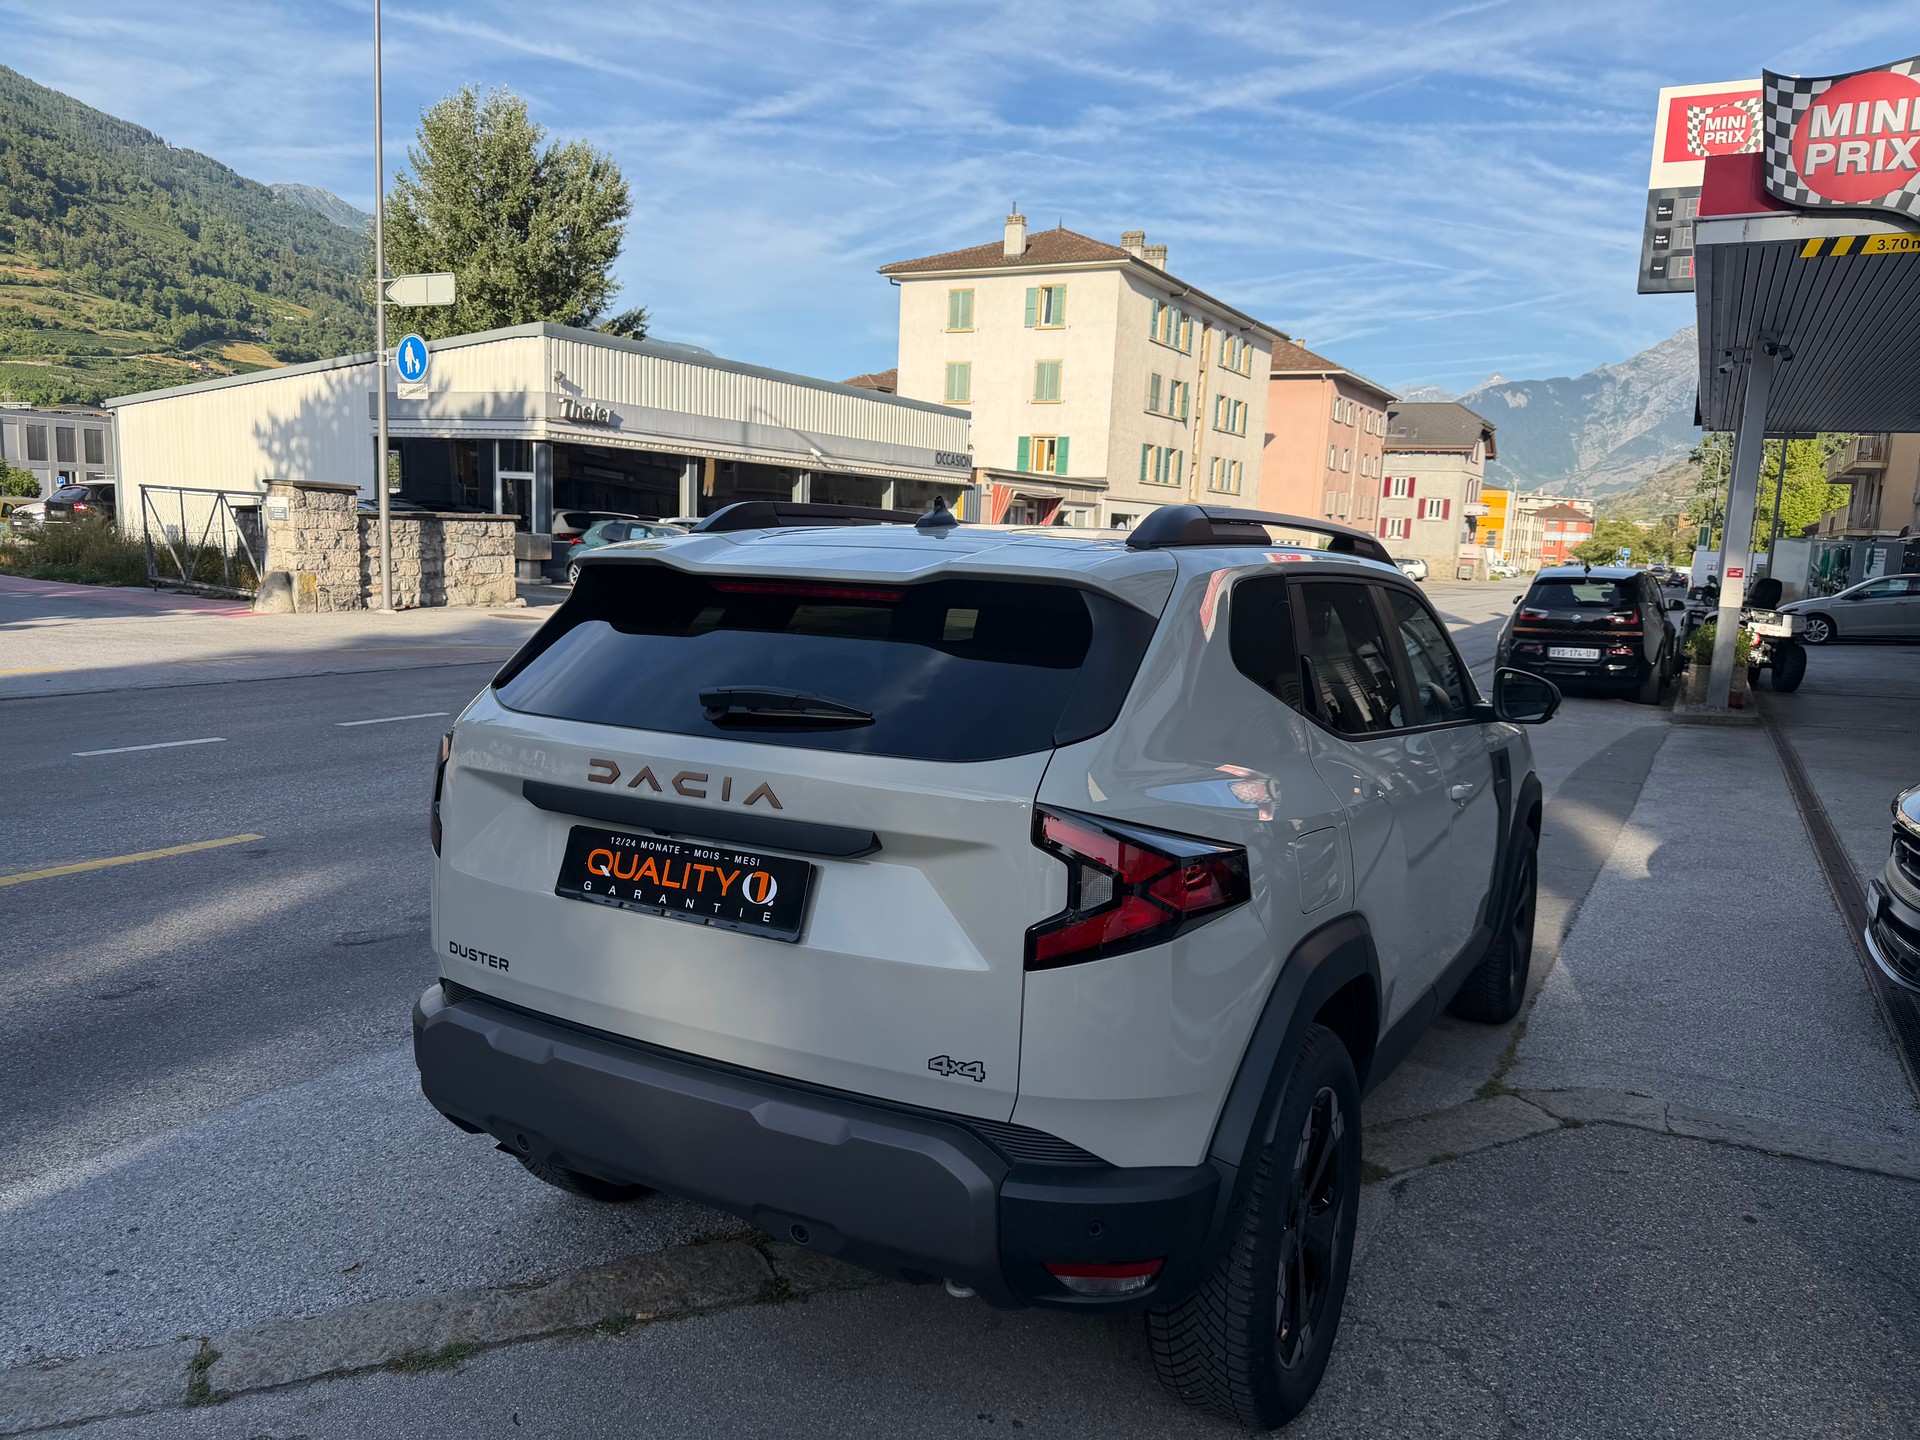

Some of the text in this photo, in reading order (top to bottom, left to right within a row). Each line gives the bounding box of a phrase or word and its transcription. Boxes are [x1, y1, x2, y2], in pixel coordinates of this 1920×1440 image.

[1705, 115, 1747, 131] MINI
[1809, 97, 1920, 140] MINI
[1704, 129, 1746, 145] PRIX
[1803, 136, 1920, 177] PRIX
[936, 452, 972, 468] OCCASION
[588, 758, 783, 809] DACIA
[610, 836, 636, 847] 12/24
[640, 840, 681, 854] MONATE
[694, 849, 720, 861] MOIS
[734, 856, 760, 866] MESI
[587, 848, 741, 896] QUALITY
[583, 880, 772, 923] GARANTIE
[449, 940, 509, 972] DUSTER
[928, 1055, 985, 1082] 4x4
